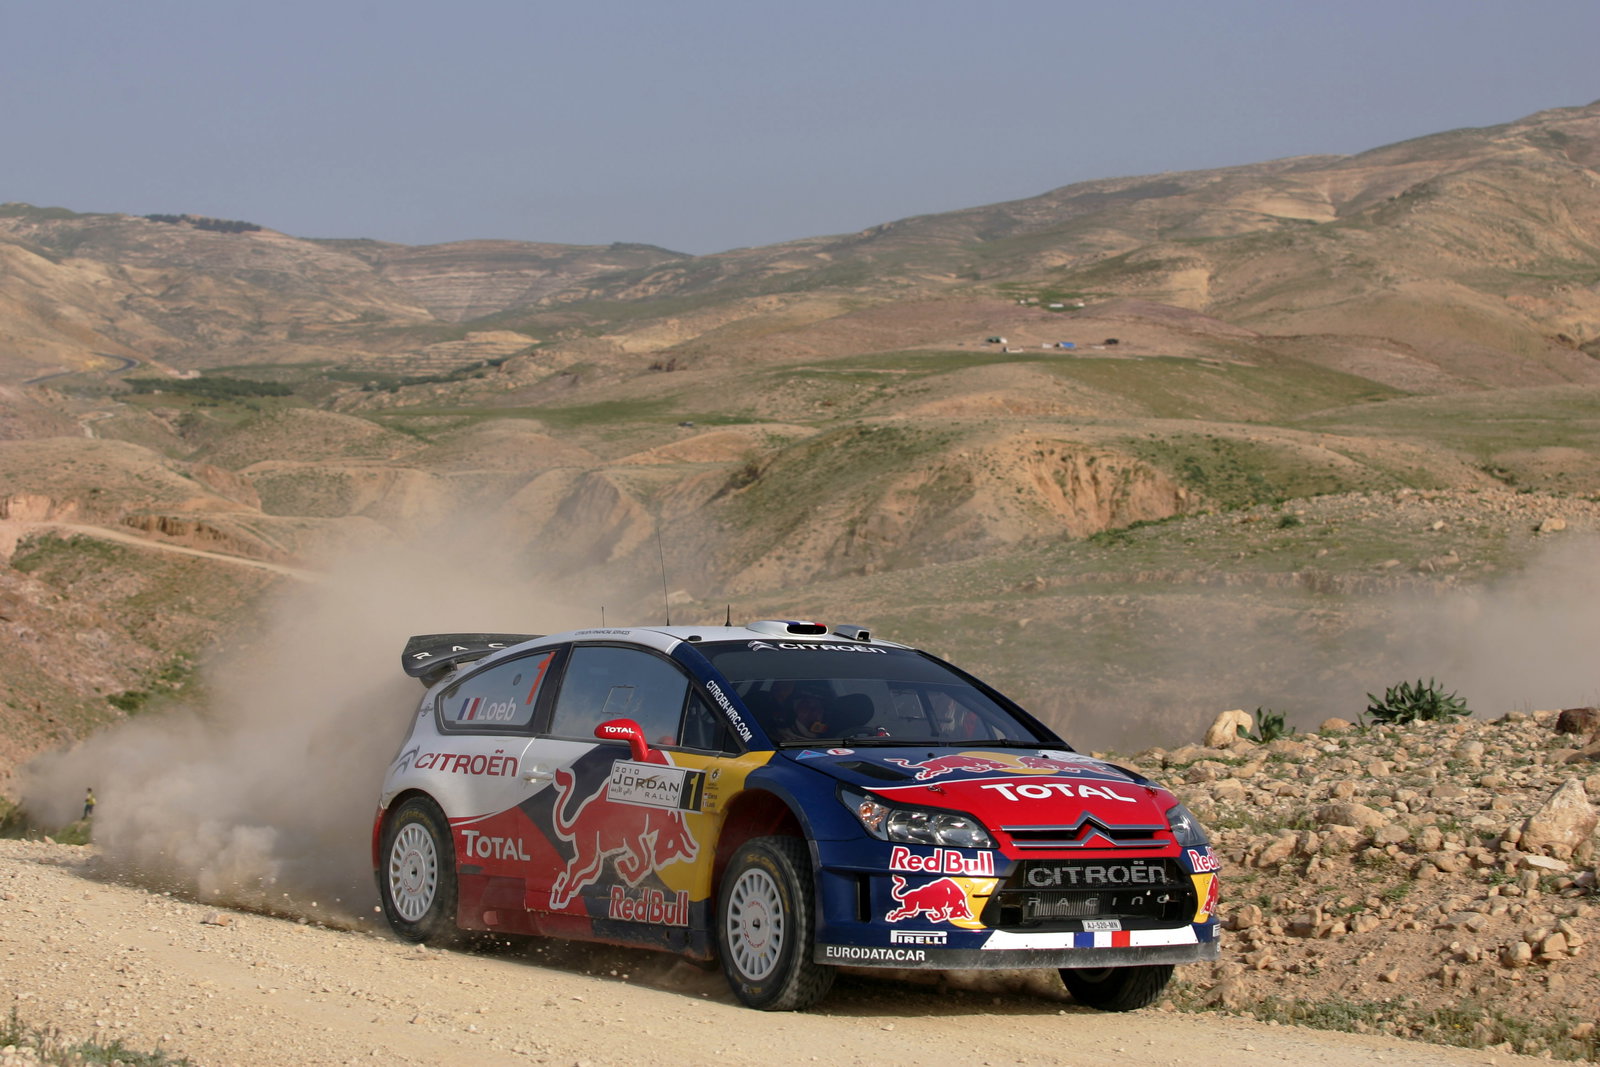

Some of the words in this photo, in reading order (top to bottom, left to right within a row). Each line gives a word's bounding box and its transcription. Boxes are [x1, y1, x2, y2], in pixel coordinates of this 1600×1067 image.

[779, 643, 887, 654] CITROËN
[525, 651, 555, 705] 1
[476, 697, 517, 721] Loeb
[706, 679, 752, 743] CITROEN-WRC.COM
[604, 726, 635, 734] TOTAL
[414, 750, 518, 777] CITROËN
[615, 767, 640, 775] 2010
[612, 774, 680, 792] JORDAN
[688, 772, 700, 809] 1
[980, 783, 1137, 803] TOTAL
[644, 791, 678, 801] RALLY
[461, 830, 530, 861] TOTAL
[890, 846, 942, 873] Red
[943, 849, 995, 876] Bull
[1027, 861, 1167, 887] CITROËN
[609, 885, 649, 919] Red
[649, 889, 689, 926] Bull
[890, 930, 948, 944] PIRELLI
[826, 946, 926, 961] EURODATACAR
